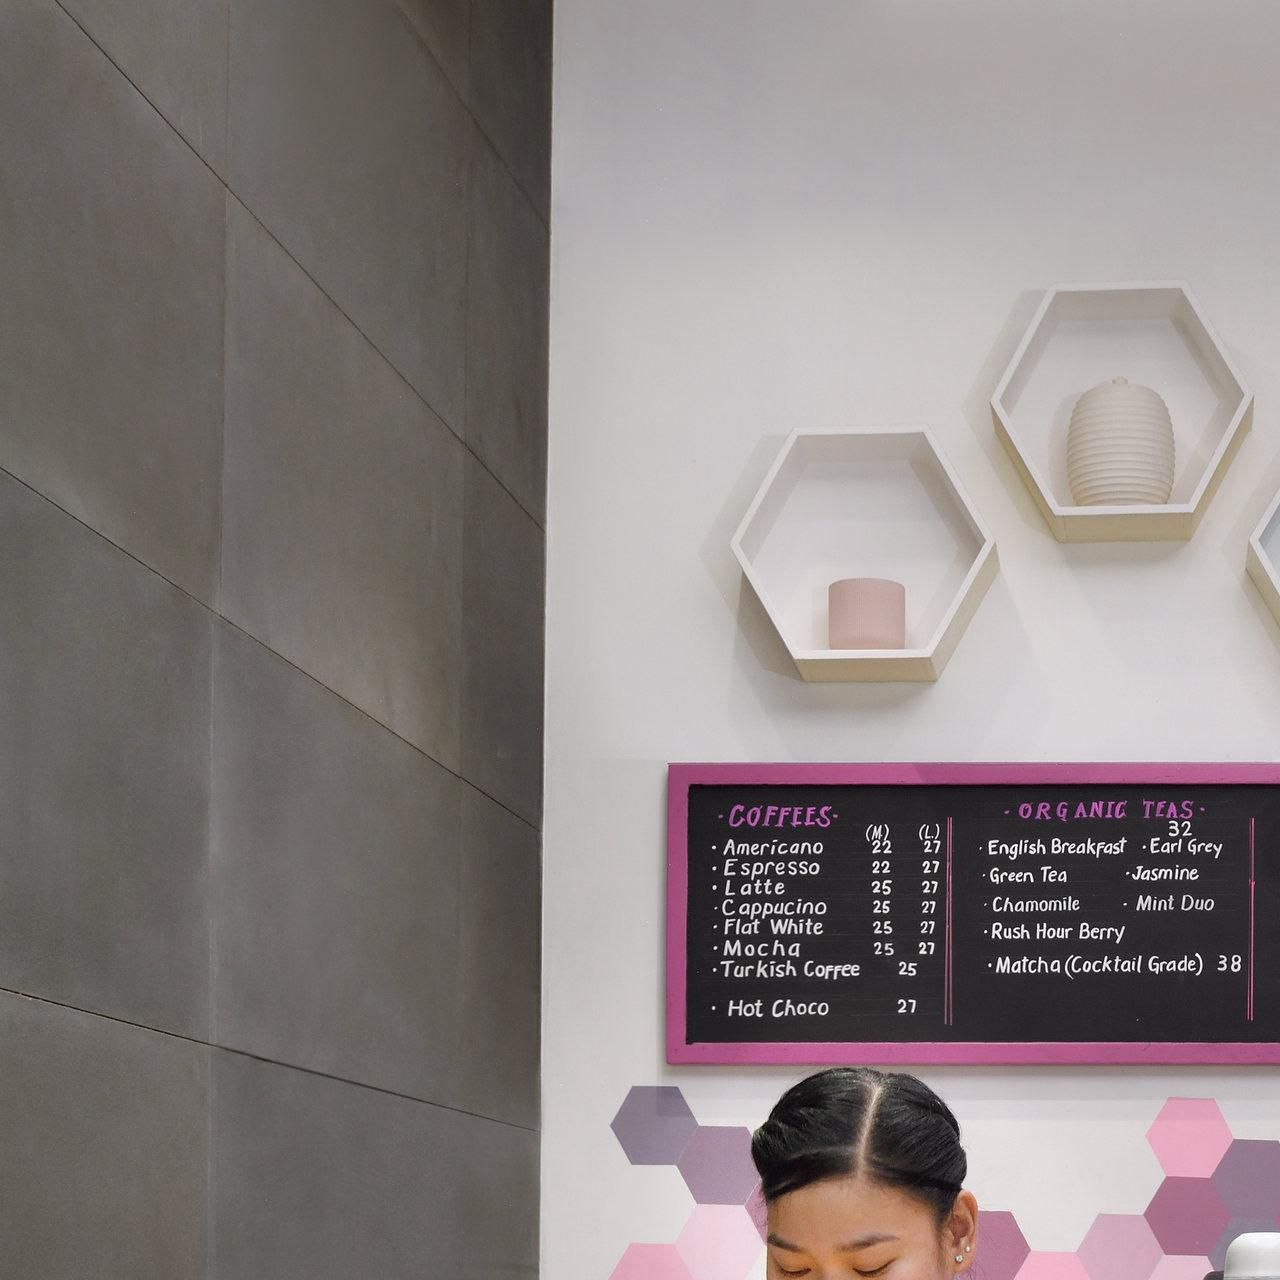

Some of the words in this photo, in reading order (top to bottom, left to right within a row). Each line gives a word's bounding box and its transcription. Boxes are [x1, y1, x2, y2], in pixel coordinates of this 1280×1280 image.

[729, 805, 832, 827] COFFEES
[1019, 801, 1127, 821] ORGANIC
[1143, 800, 1193, 819] TEAS
[1169, 821, 1192, 836] 32
[723, 839, 823, 855] Americano
[872, 840, 892, 854] 22
[924, 840, 941, 853] 27
[988, 839, 1046, 860] English
[1051, 837, 1127, 858] Breakfast
[1150, 837, 1182, 853] Earl
[1188, 838, 1222, 859] Grey
[724, 859, 820, 880] Espresso
[872, 861, 890, 873] 22
[922, 861, 939, 873] 27
[990, 867, 1034, 884] Green
[1041, 866, 1067, 882] Tea
[1132, 865, 1199, 881] Jasmine
[725, 879, 785, 896] Latte
[872, 880, 892, 895] 25
[922, 881, 938, 893] 27
[722, 899, 826, 920] Cappucino
[873, 900, 890, 913] 25
[922, 901, 936, 913] 27
[993, 896, 1080, 912] Chamomile
[1136, 895, 1174, 911] Mint
[1181, 895, 1214, 911] Duo
[724, 919, 760, 935] Flat
[770, 918, 823, 935] White
[873, 921, 892, 934] 25
[921, 921, 935, 934] 27
[992, 922, 1030, 939] Rush
[1036, 923, 1073, 939] Hour
[1079, 922, 1125, 944] Berry
[724, 940, 800, 957] Mocha
[874, 942, 894, 956] 25
[919, 942, 935, 954] 27
[720, 960, 796, 978] Turkish
[804, 961, 860, 980] Coffee
[899, 961, 917, 976] 25
[1148, 953, 1203, 976] Grade)
[1217, 955, 1241, 972] 38
[728, 1000, 763, 1017] Hot
[772, 999, 829, 1017] Choco
[898, 999, 916, 1013] 27
